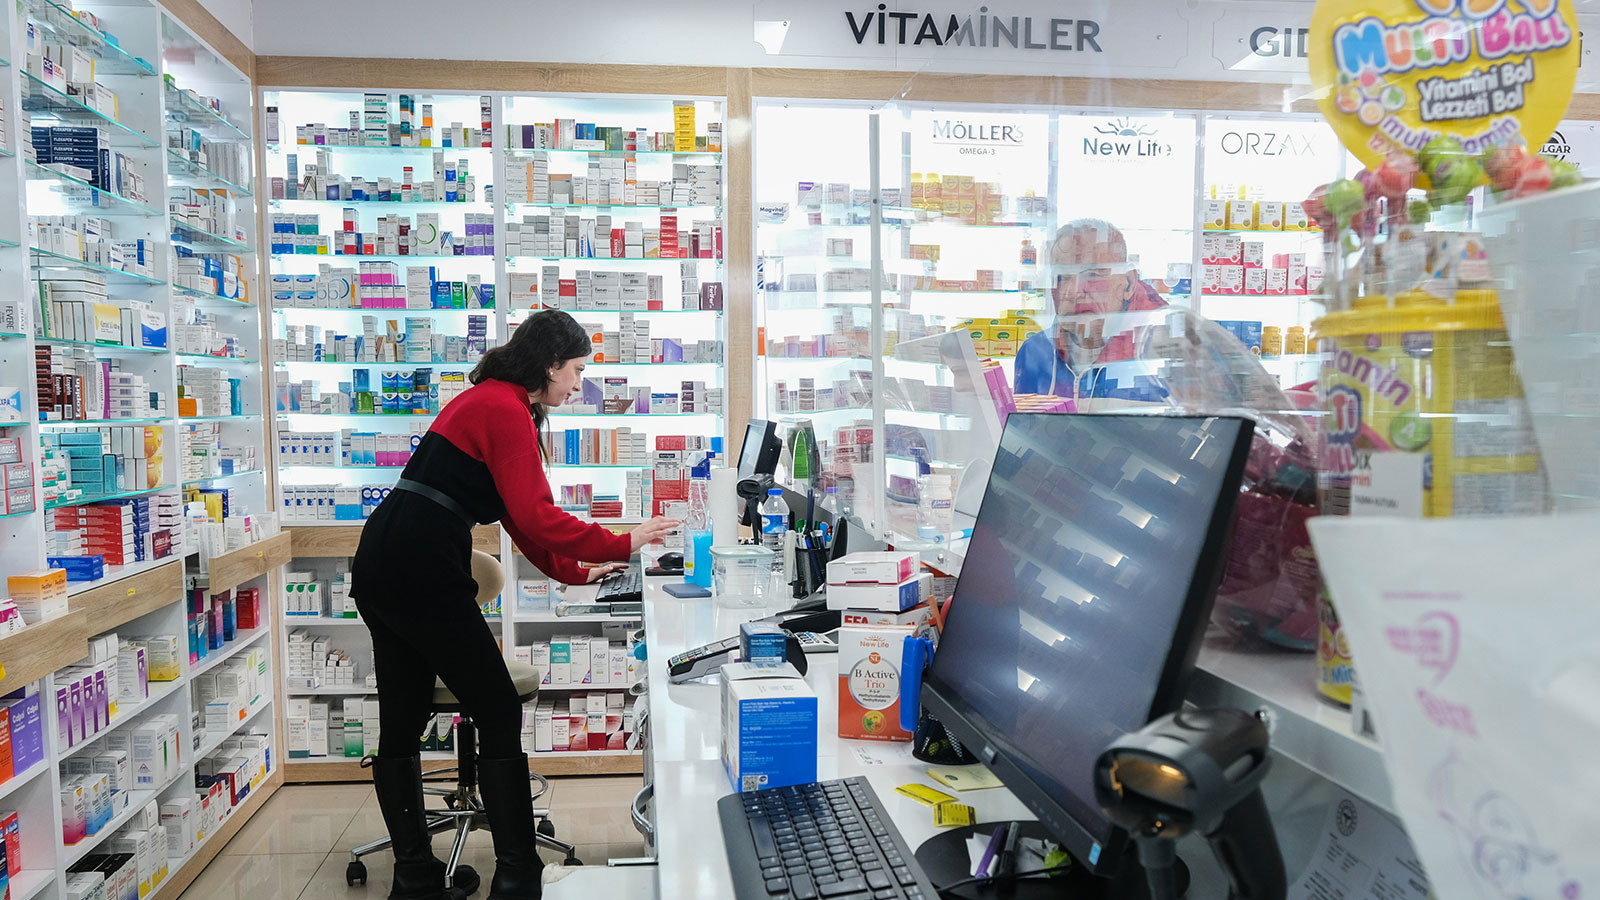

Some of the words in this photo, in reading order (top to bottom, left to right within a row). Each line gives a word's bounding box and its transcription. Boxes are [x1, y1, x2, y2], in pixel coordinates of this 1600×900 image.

[845, 3, 1103, 52] VİTAMİNLER
[1481, 8, 1566, 55] BALL
[1418, 66, 1498, 100] Vitamini
[1502, 57, 1533, 85] Bol
[1421, 94, 1490, 121] Lezzeti
[1492, 86, 1524, 113] Bol
[933, 119, 1024, 143] MÖLLER'S
[959, 147, 996, 156] OMEGA-3
[1083, 138, 1130, 156] New
[1137, 138, 1172, 157] Life
[1221, 131, 1316, 156] ORZAX
[855, 669, 862, 677] B
[864, 669, 896, 680] Active
[864, 679, 886, 689] Trio
[12, 710, 25, 724] Calpol
[27, 702, 39, 715] Calpol
